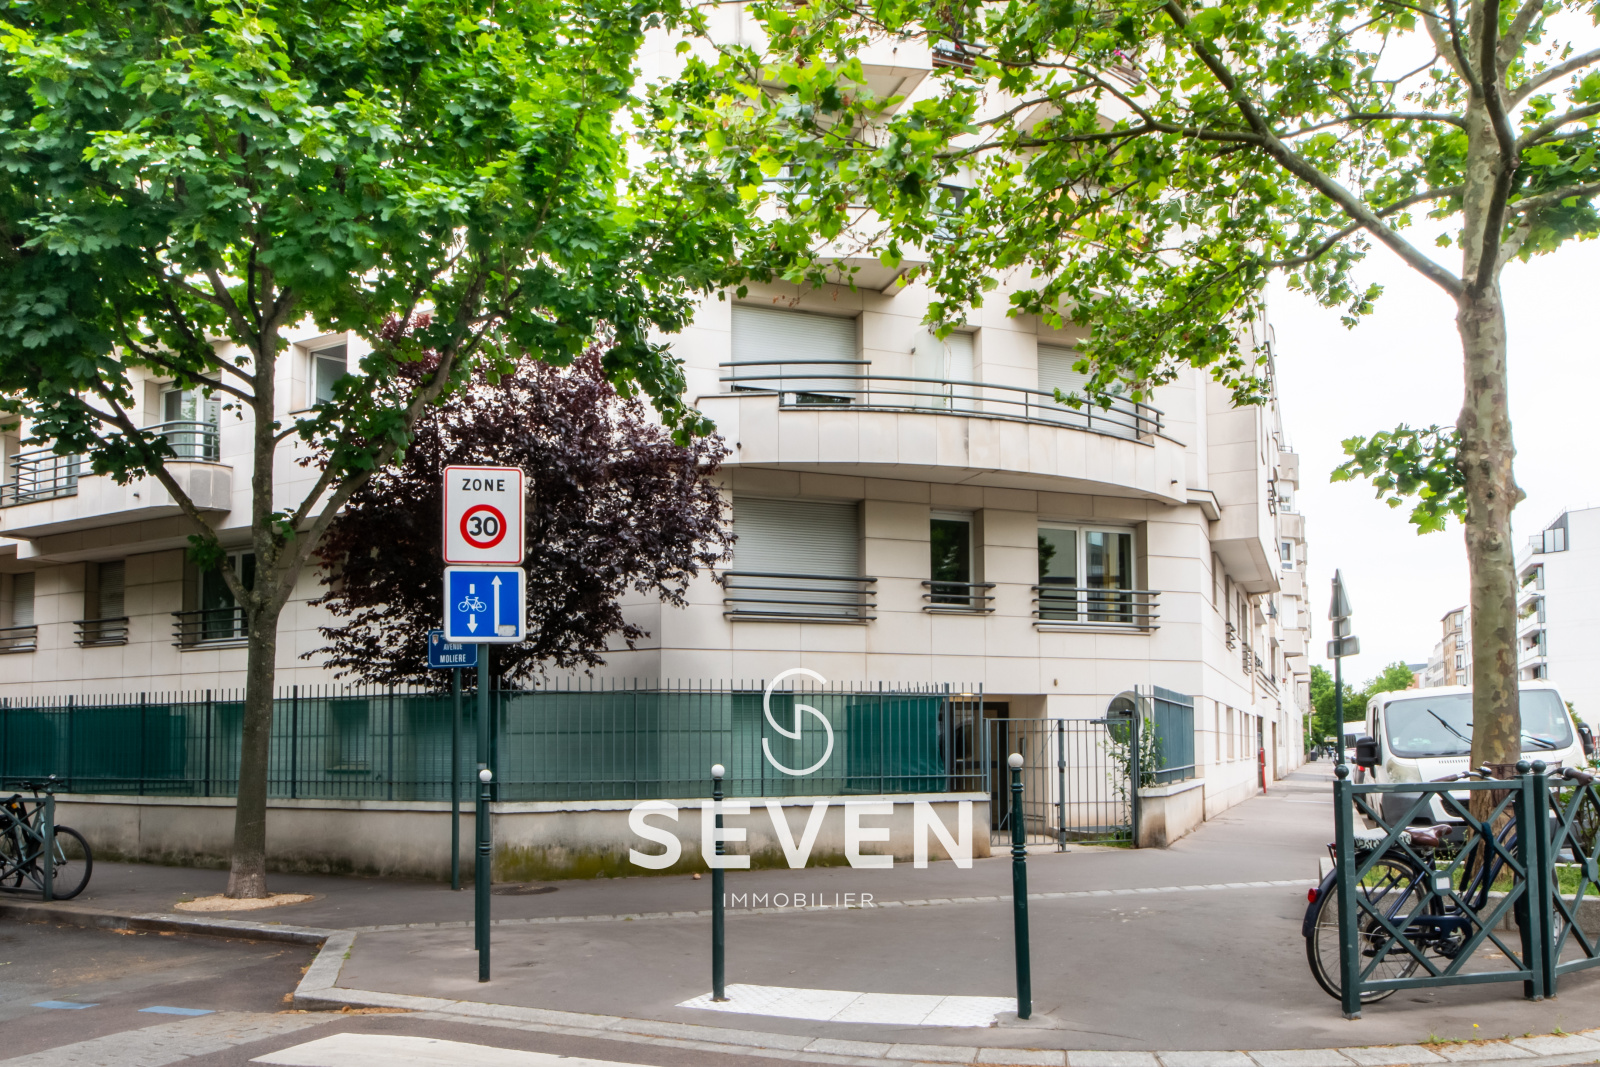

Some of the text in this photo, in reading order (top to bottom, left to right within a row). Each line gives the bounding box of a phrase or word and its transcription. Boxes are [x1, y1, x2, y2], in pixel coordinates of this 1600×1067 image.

[462, 478, 506, 491] ZONE
[469, 516, 499, 537] 30
[443, 643, 463, 651] AVENUE
[439, 654, 466, 664] MOLIERE
